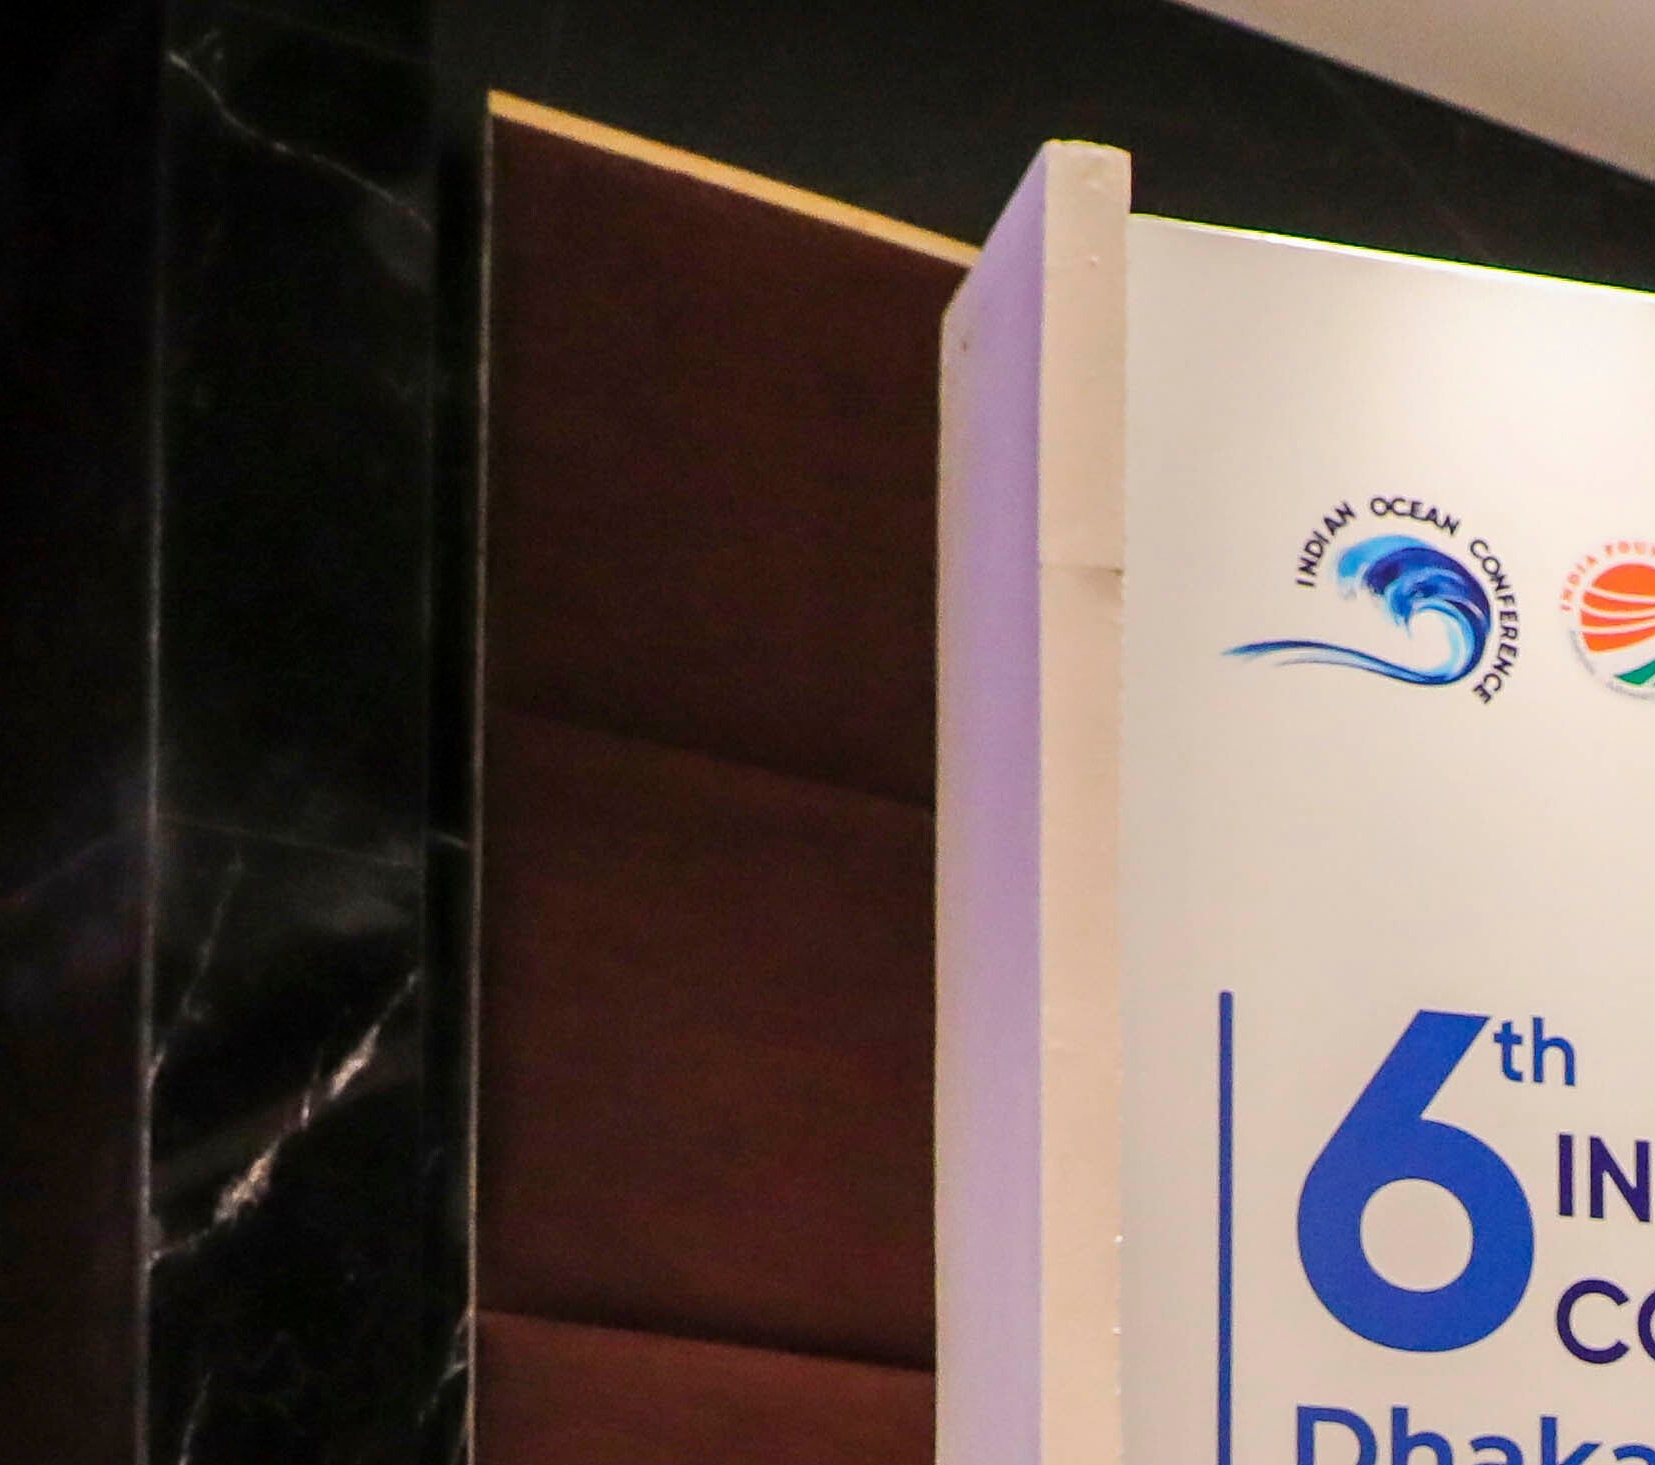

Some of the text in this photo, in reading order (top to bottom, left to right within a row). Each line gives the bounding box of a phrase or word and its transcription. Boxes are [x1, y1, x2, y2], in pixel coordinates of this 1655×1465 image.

[1297, 502, 1356, 587] INDIAN
[1370, 497, 1460, 535] OCEAN
[1469, 539, 1518, 704] CONFERENCE
